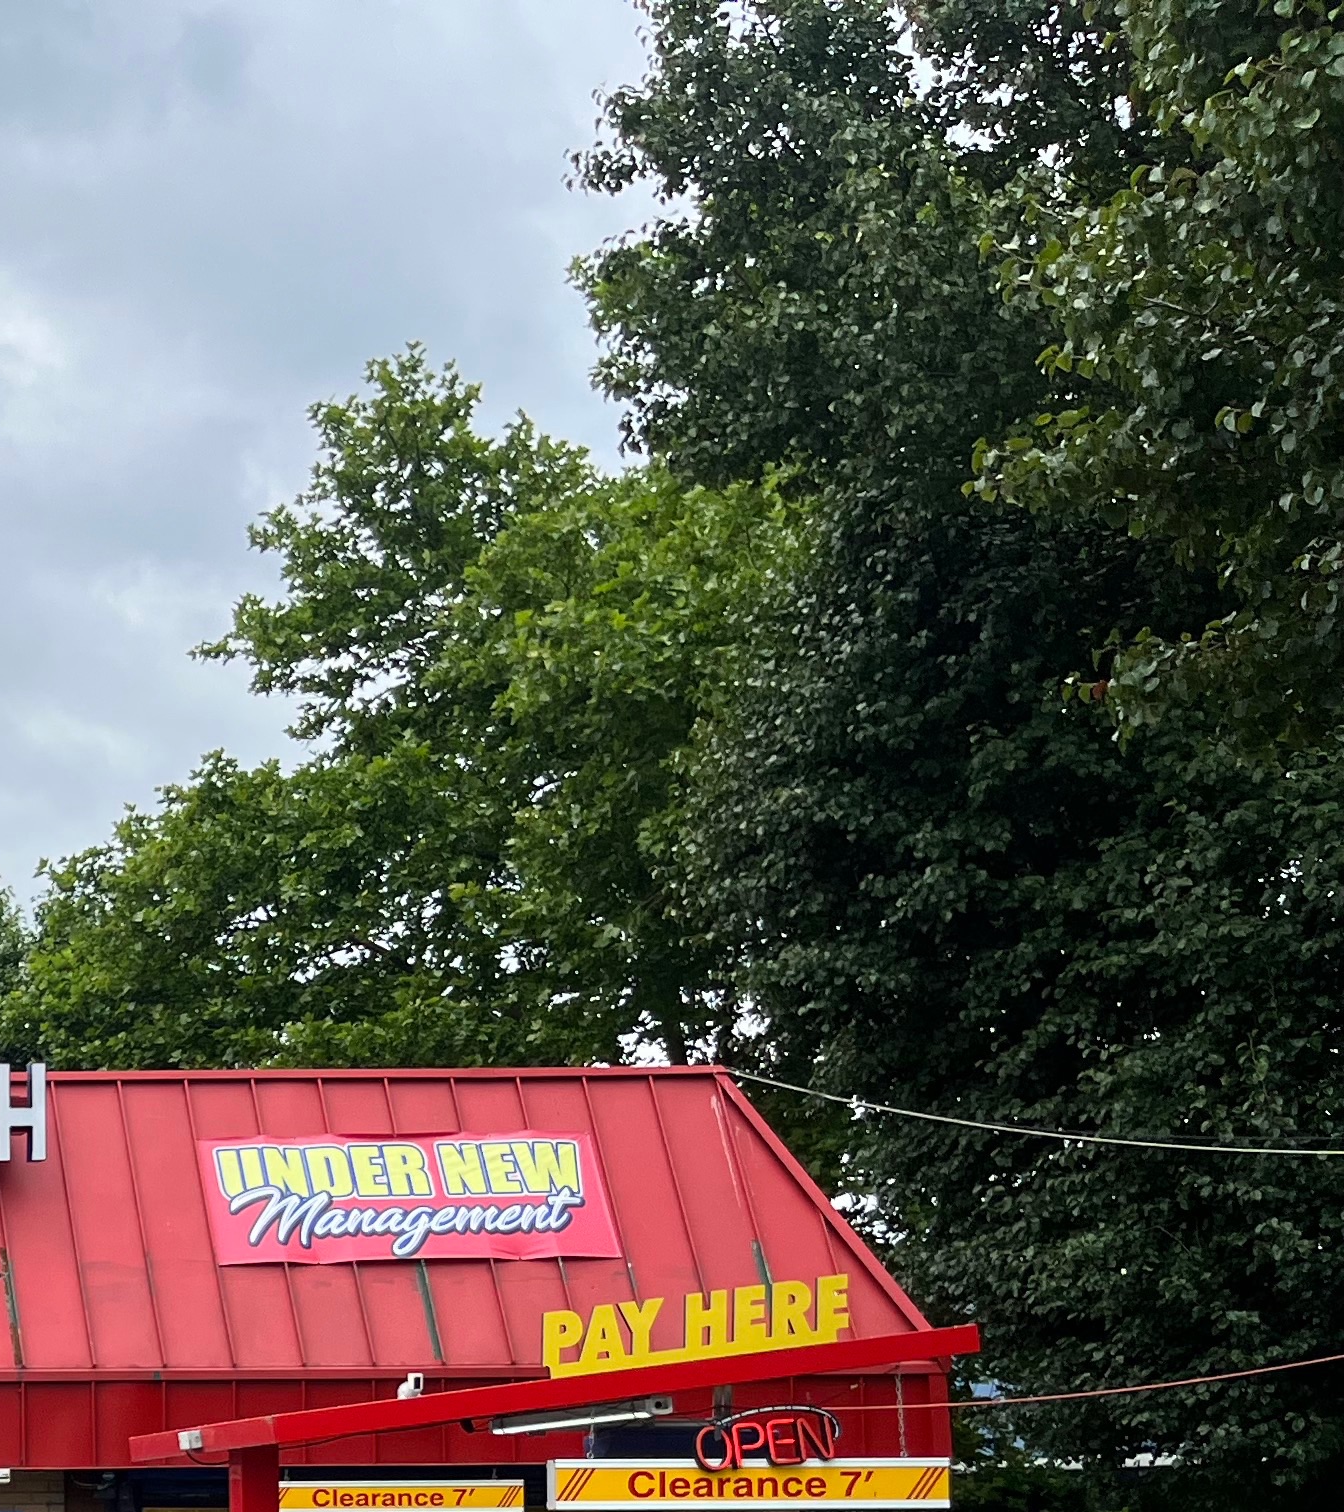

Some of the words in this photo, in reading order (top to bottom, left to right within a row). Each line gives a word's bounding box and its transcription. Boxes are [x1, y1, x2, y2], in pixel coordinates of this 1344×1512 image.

[213, 1142, 436, 1201] UNDER
[433, 1139, 582, 1196] NEW
[230, 1185, 585, 1257] Management
[542, 1297, 664, 1370] PAY
[683, 1274, 849, 1348] HERE
[695, 1415, 837, 1472] OPEN
[312, 1488, 444, 1508] Clearance
[452, 1488, 476, 1507] 7'
[627, 1470, 827, 1499] Clearance
[839, 1471, 874, 1498] 7'
